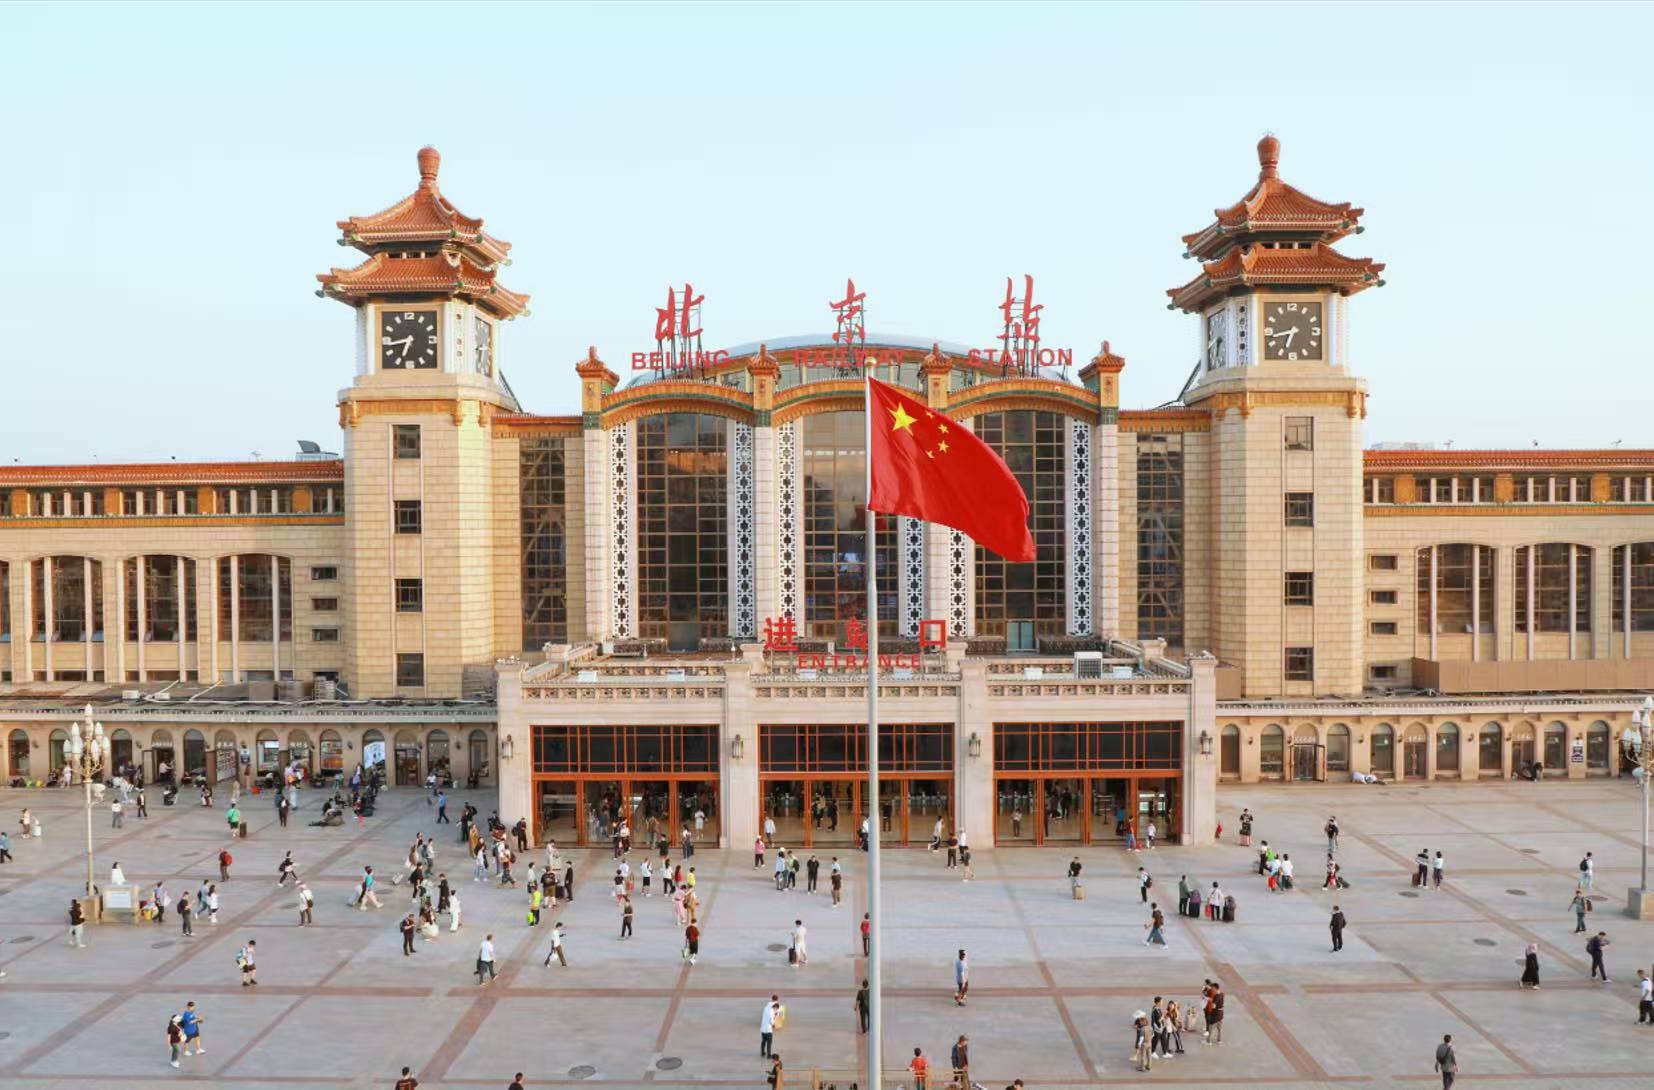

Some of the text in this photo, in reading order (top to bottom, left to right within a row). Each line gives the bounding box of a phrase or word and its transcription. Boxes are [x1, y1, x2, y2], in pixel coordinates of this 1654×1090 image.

[1286, 303, 1298, 311] 12
[404, 312, 415, 320] 12
[632, 350, 731, 370] BEIJING
[967, 348, 1073, 368] STATION
[763, 616, 947, 650] 进站口
